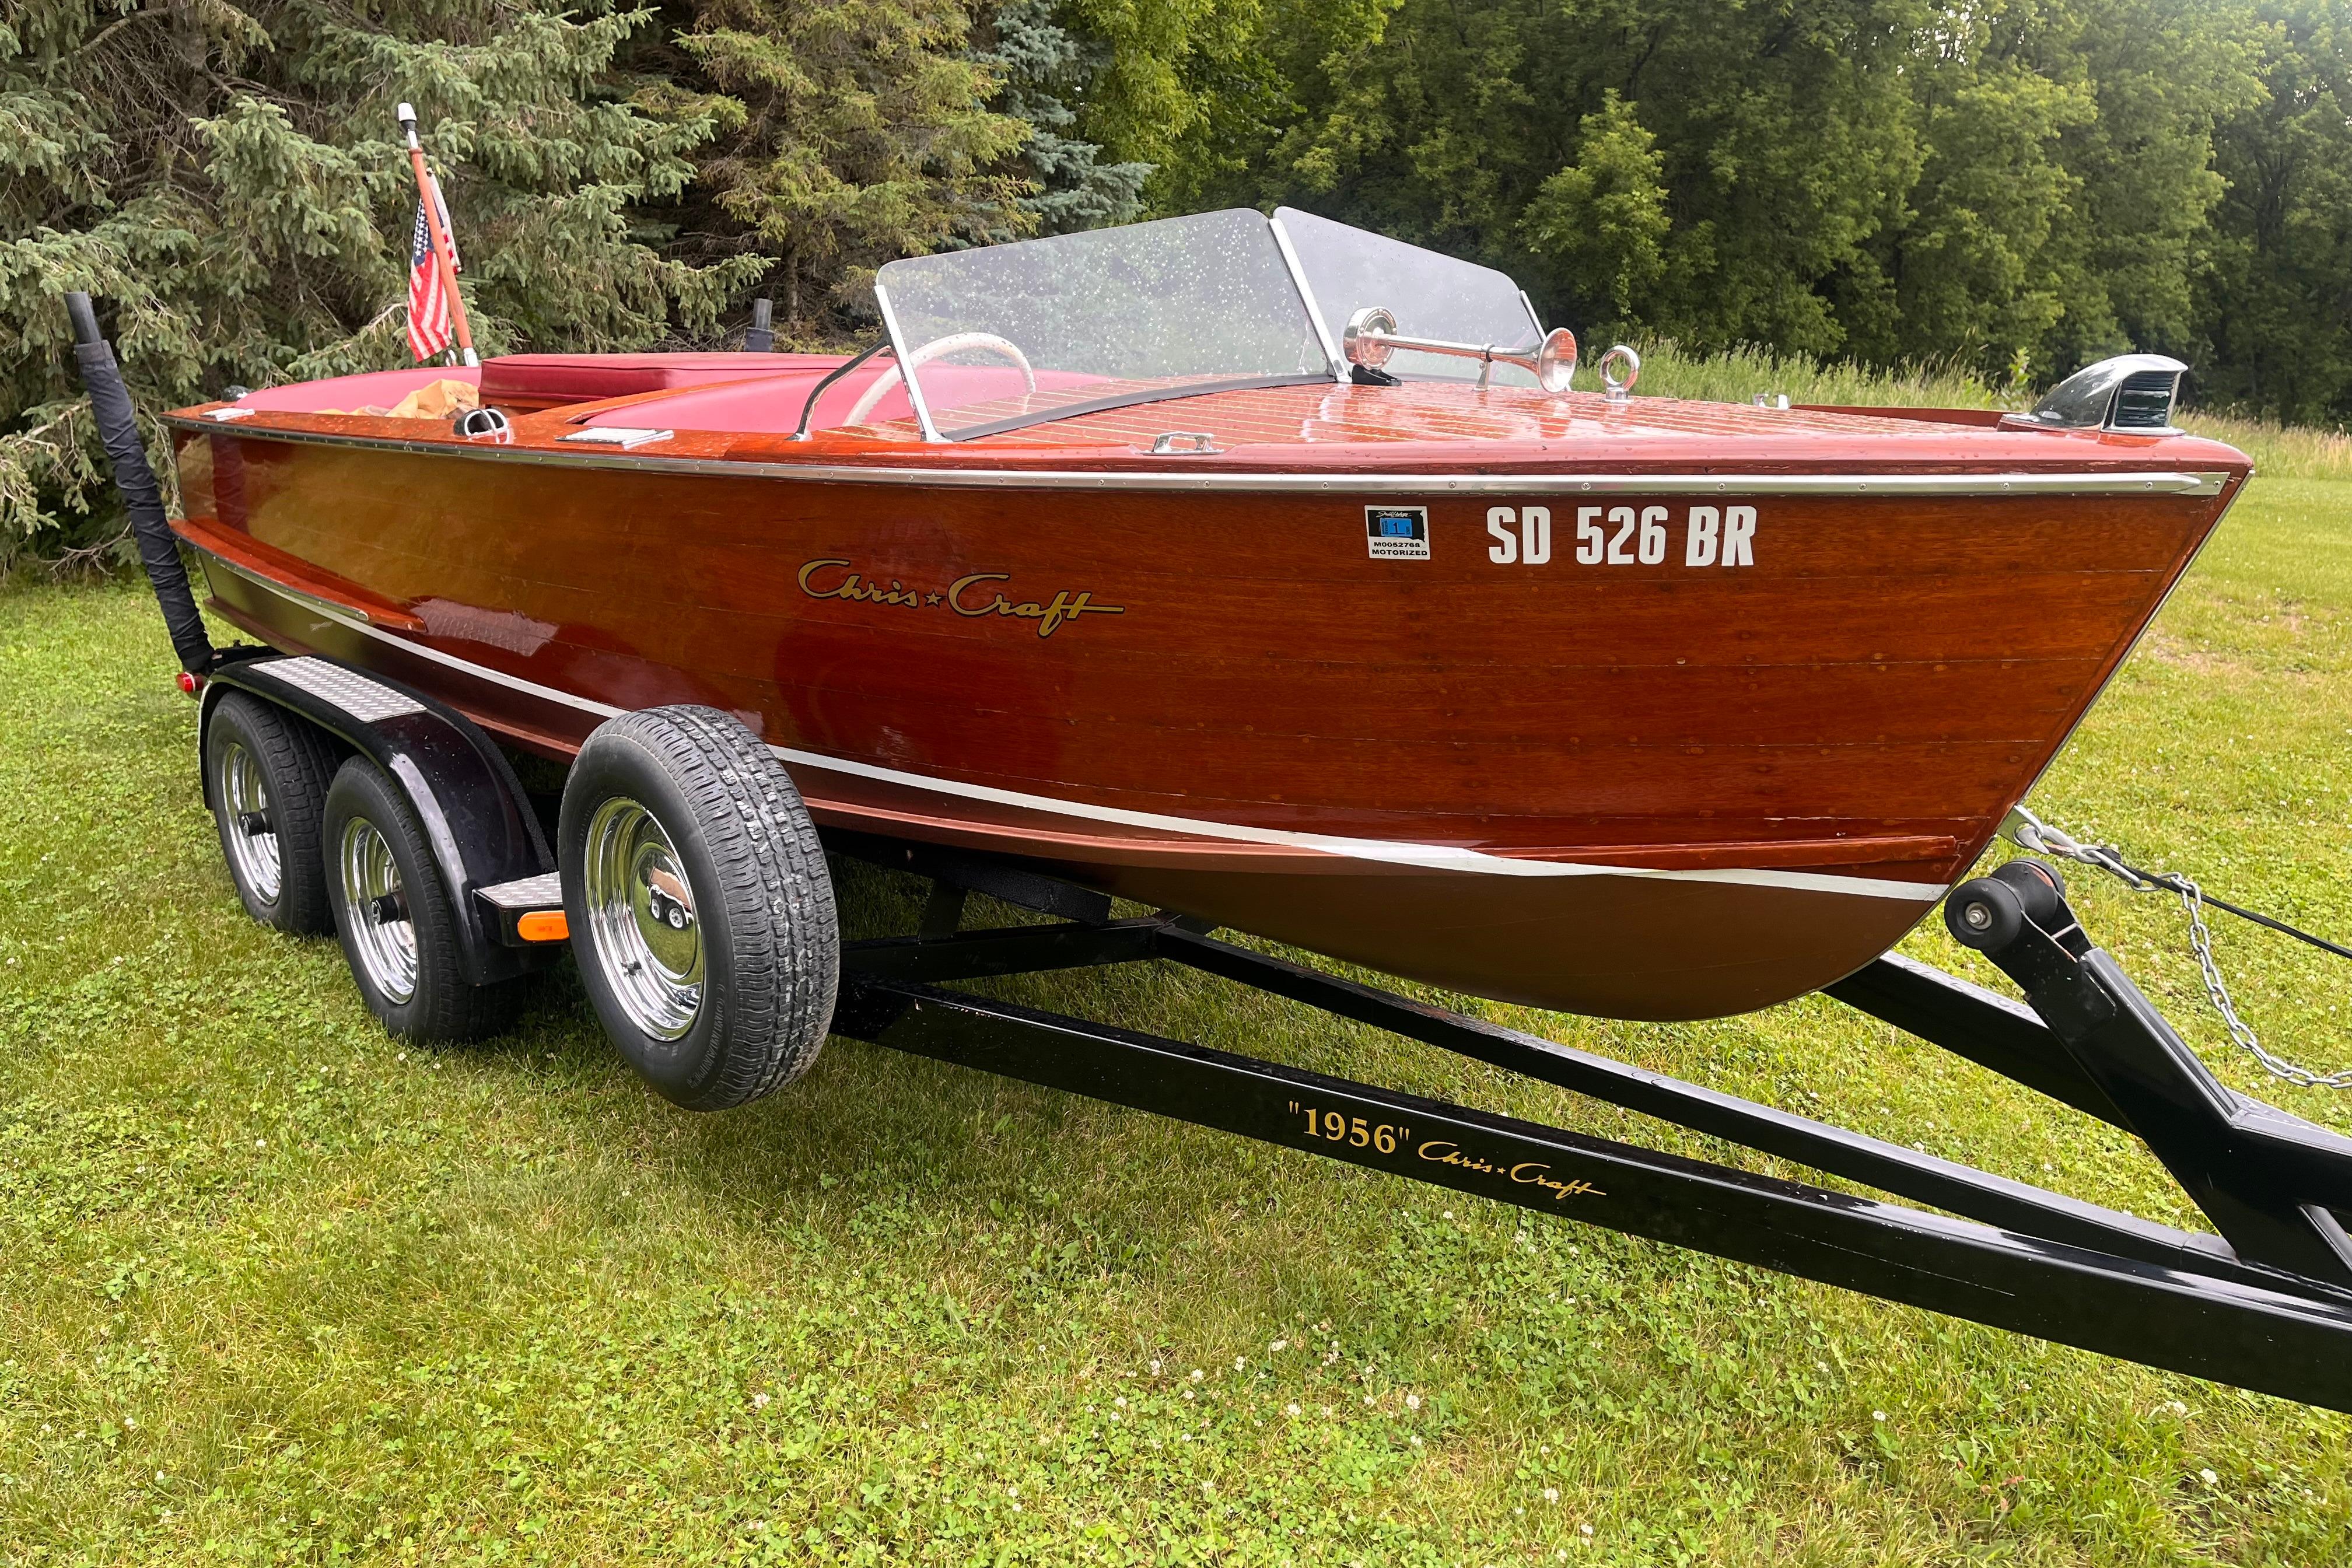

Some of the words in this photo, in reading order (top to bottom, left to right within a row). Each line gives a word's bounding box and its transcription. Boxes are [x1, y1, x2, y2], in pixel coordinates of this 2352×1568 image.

[1487, 506, 1550, 564] SD
[1576, 506, 1668, 565] 526
[1685, 506, 1757, 566] BR
[797, 558, 918, 608] Chris
[947, 572, 1126, 639] Craft
[1418, 1141, 1492, 1173] Chris
[1510, 1163, 1607, 1200] Craft
